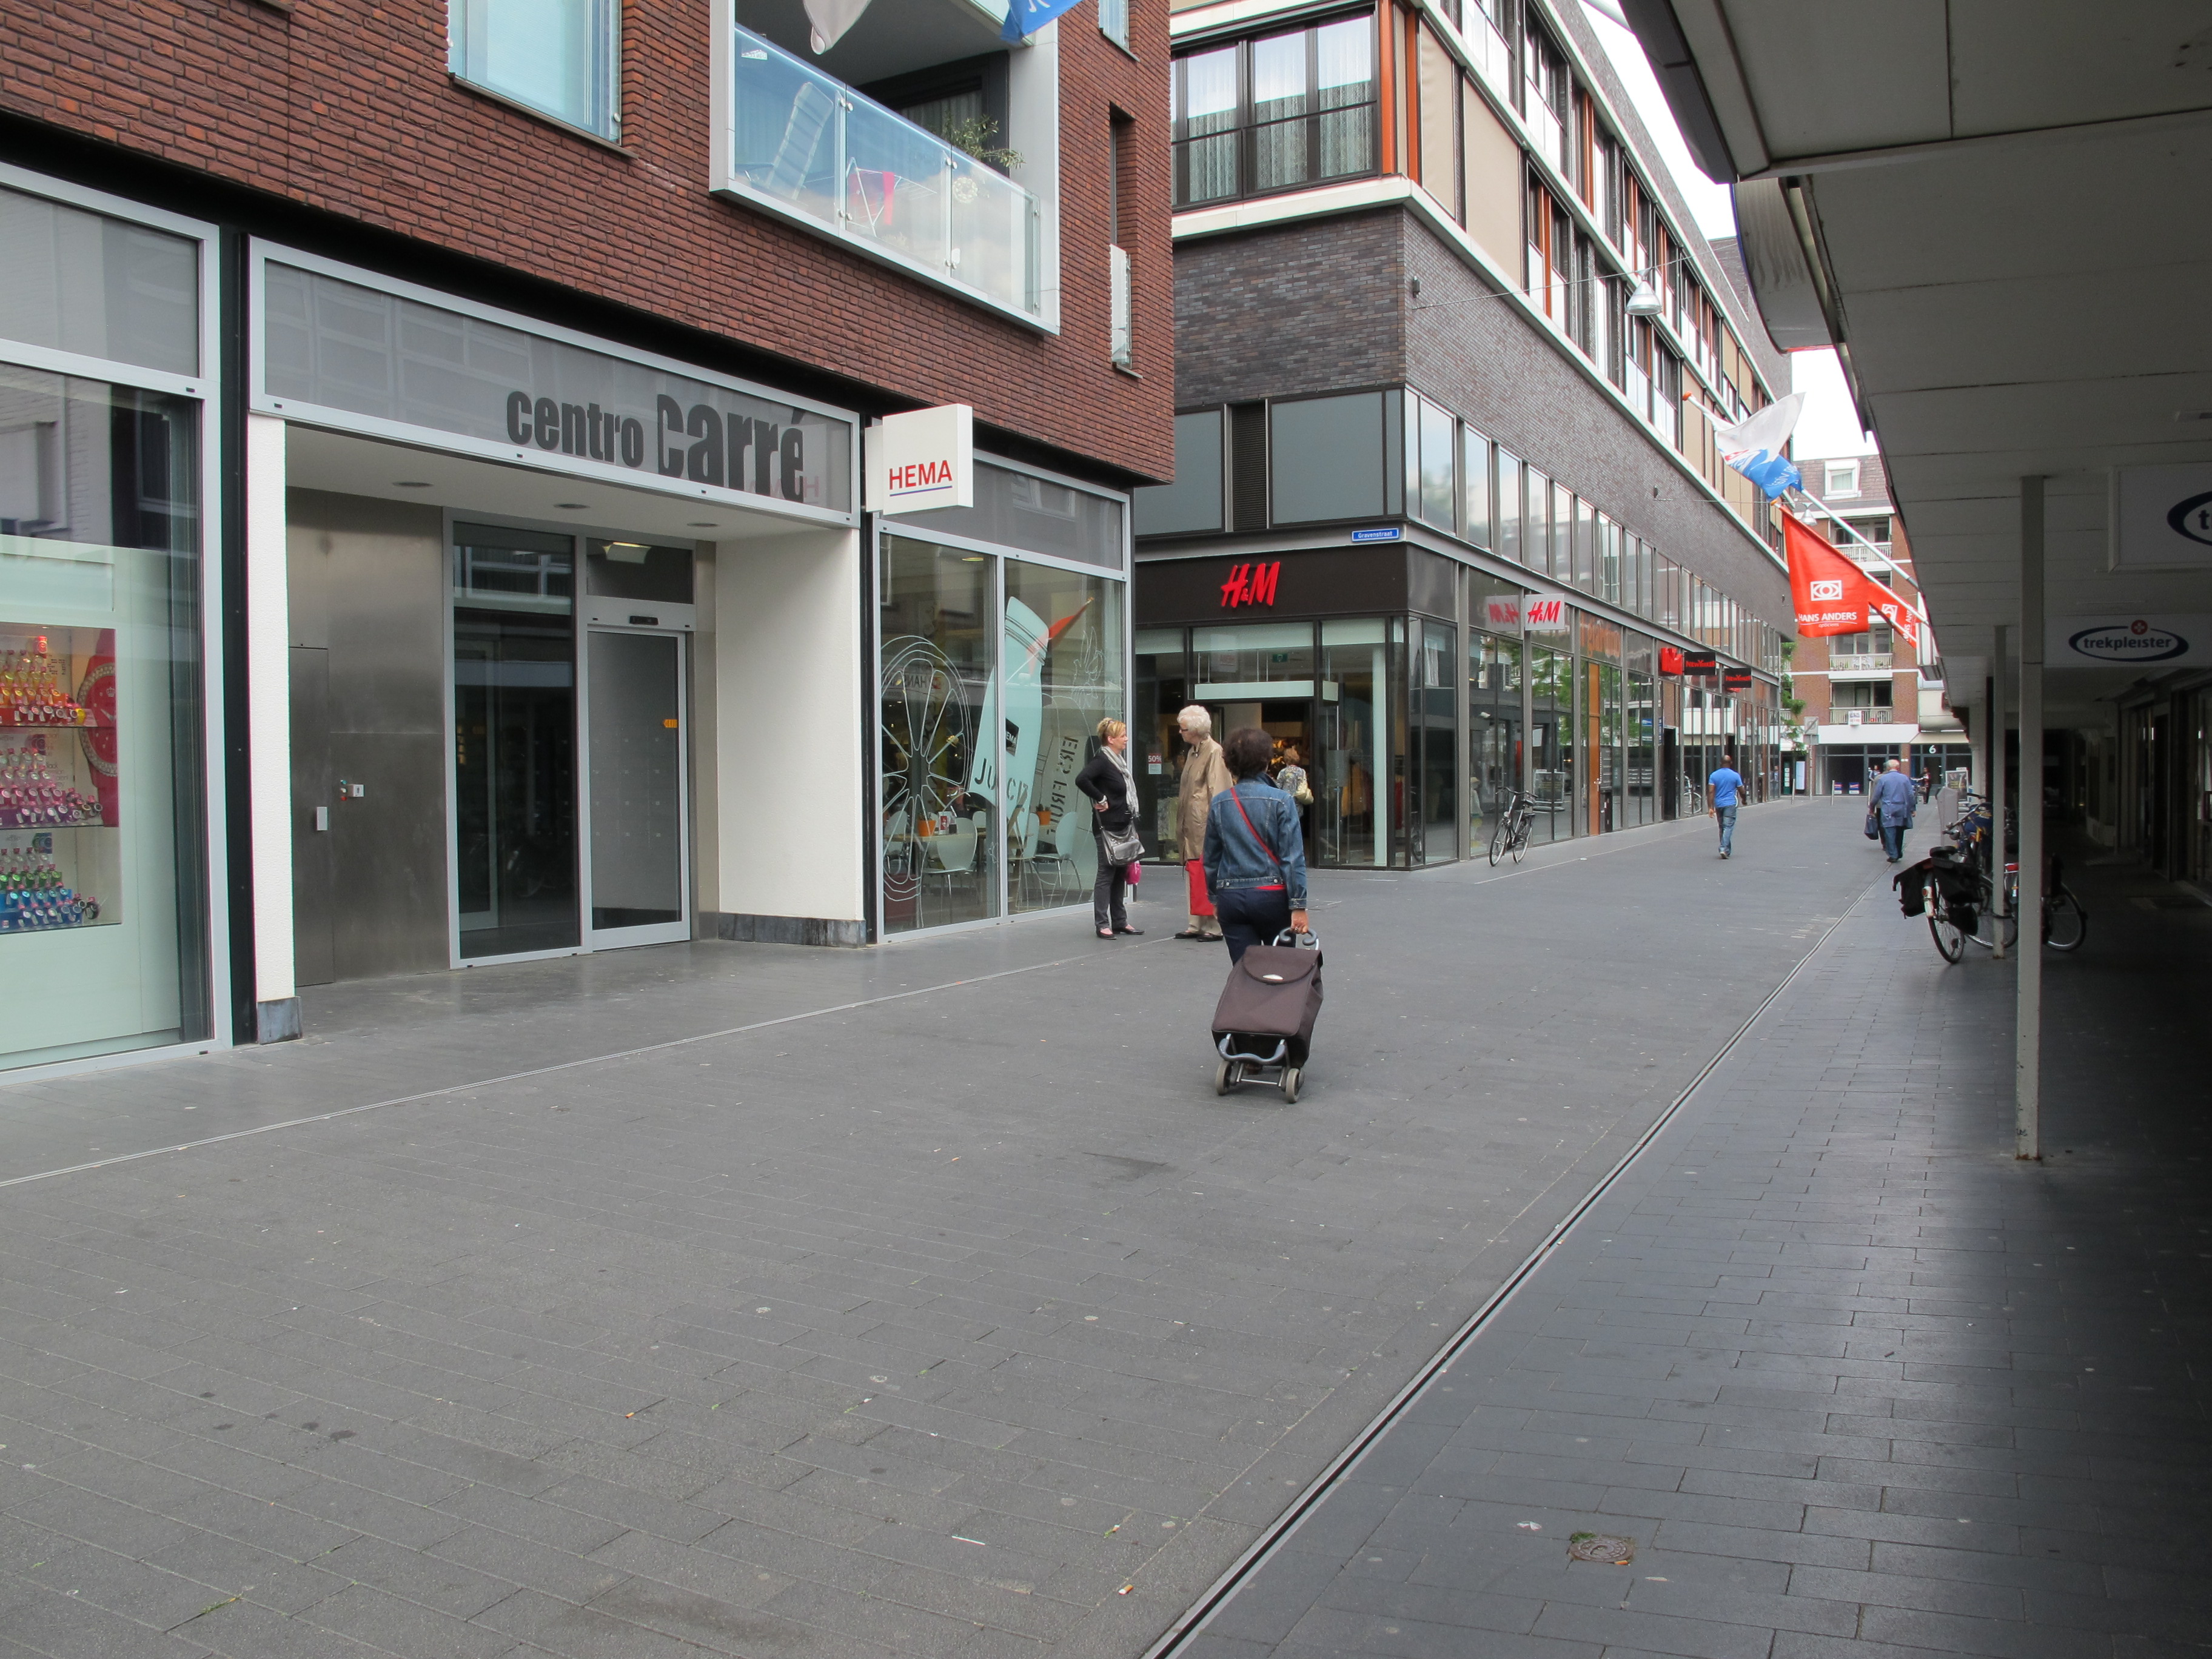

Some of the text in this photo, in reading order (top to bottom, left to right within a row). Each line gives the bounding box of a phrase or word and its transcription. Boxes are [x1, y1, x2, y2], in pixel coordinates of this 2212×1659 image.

[507, 390, 644, 468] centro
[889, 460, 953, 490] HEMA
[1221, 561, 1280, 608] H&M
[1527, 600, 1561, 624] H&M
[1798, 612, 1857, 622] HANS ANDERS
[2083, 637, 2171, 651] trekpleister
[1929, 745, 1936, 754] 6
